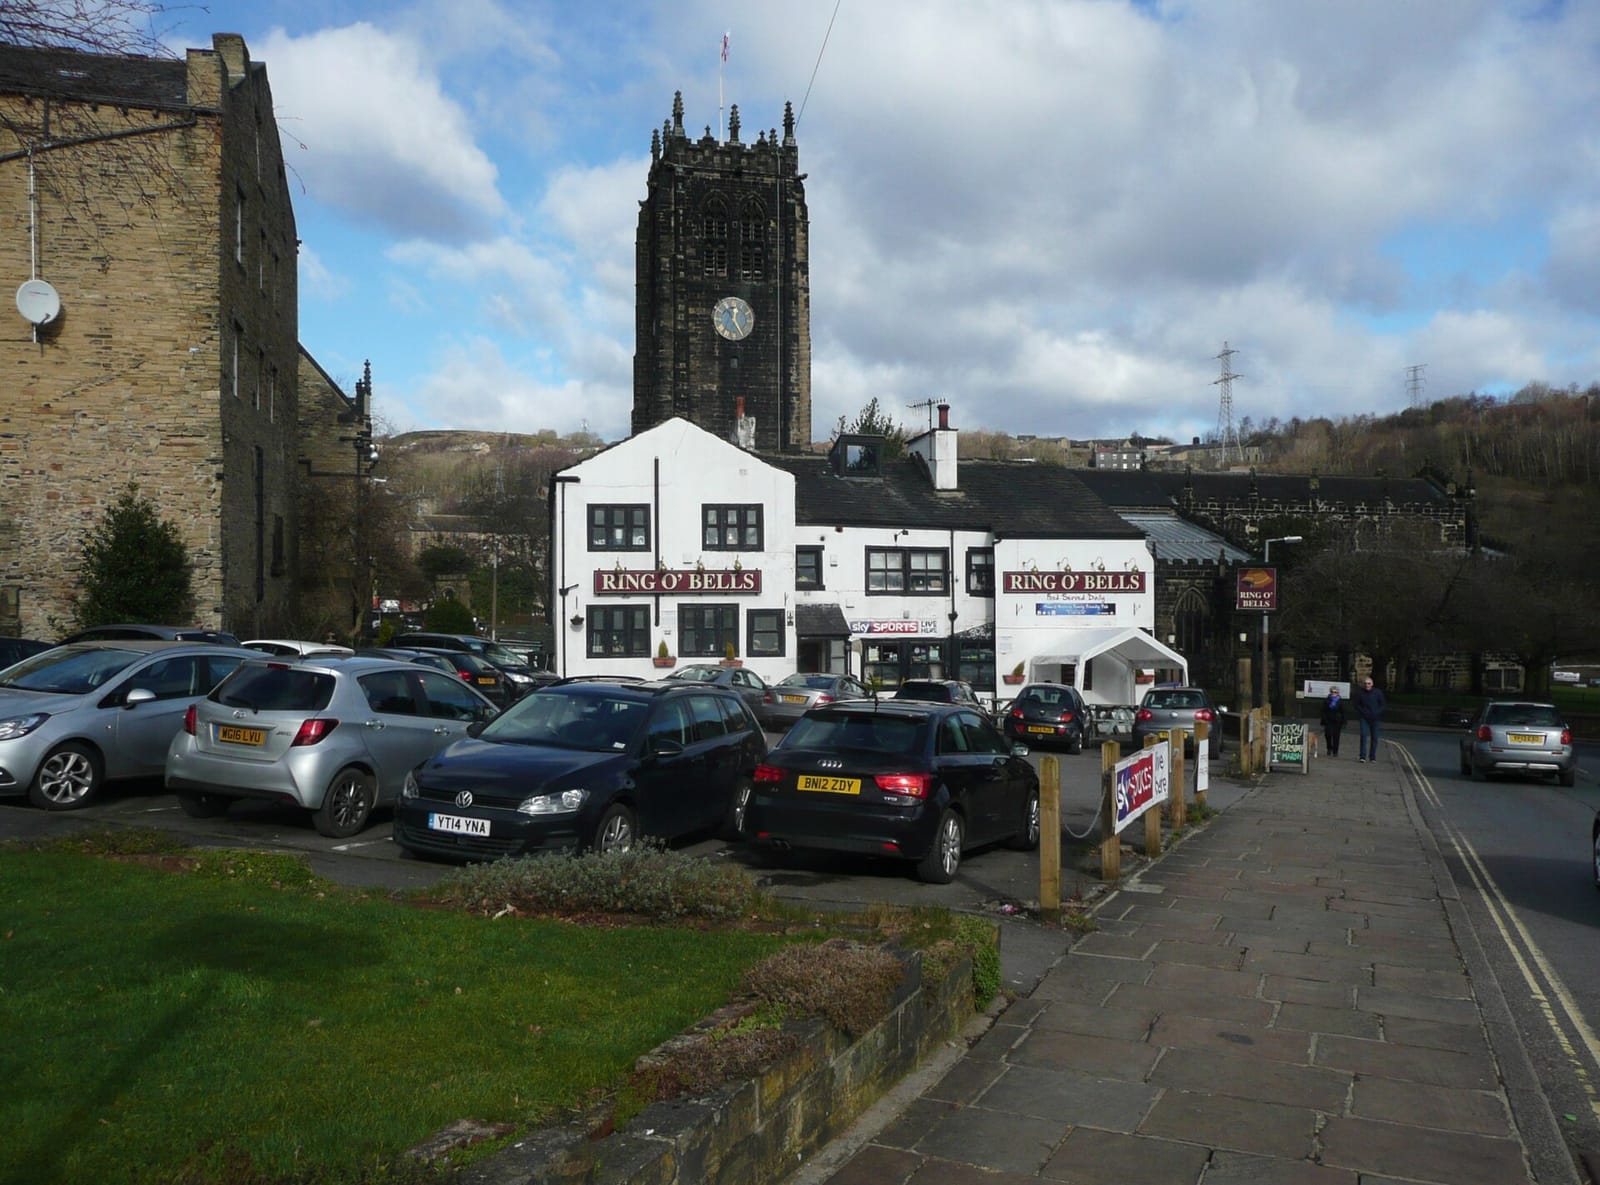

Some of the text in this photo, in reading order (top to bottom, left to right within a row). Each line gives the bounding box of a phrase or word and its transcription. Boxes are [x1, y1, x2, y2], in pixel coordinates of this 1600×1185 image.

[602, 573, 656, 590] RING
[688, 573, 754, 590] BELLS
[1010, 574, 1057, 590] RING
[1084, 574, 1140, 590] BELLS
[1240, 591, 1262, 599] RING
[852, 622, 917, 632] sky SPORTS
[1272, 724, 1304, 736] CURRY
[1272, 735, 1300, 744] NIGHT
[804, 777, 854, 791] BN12 ZDY
[438, 816, 486, 833] YT14 YNA
